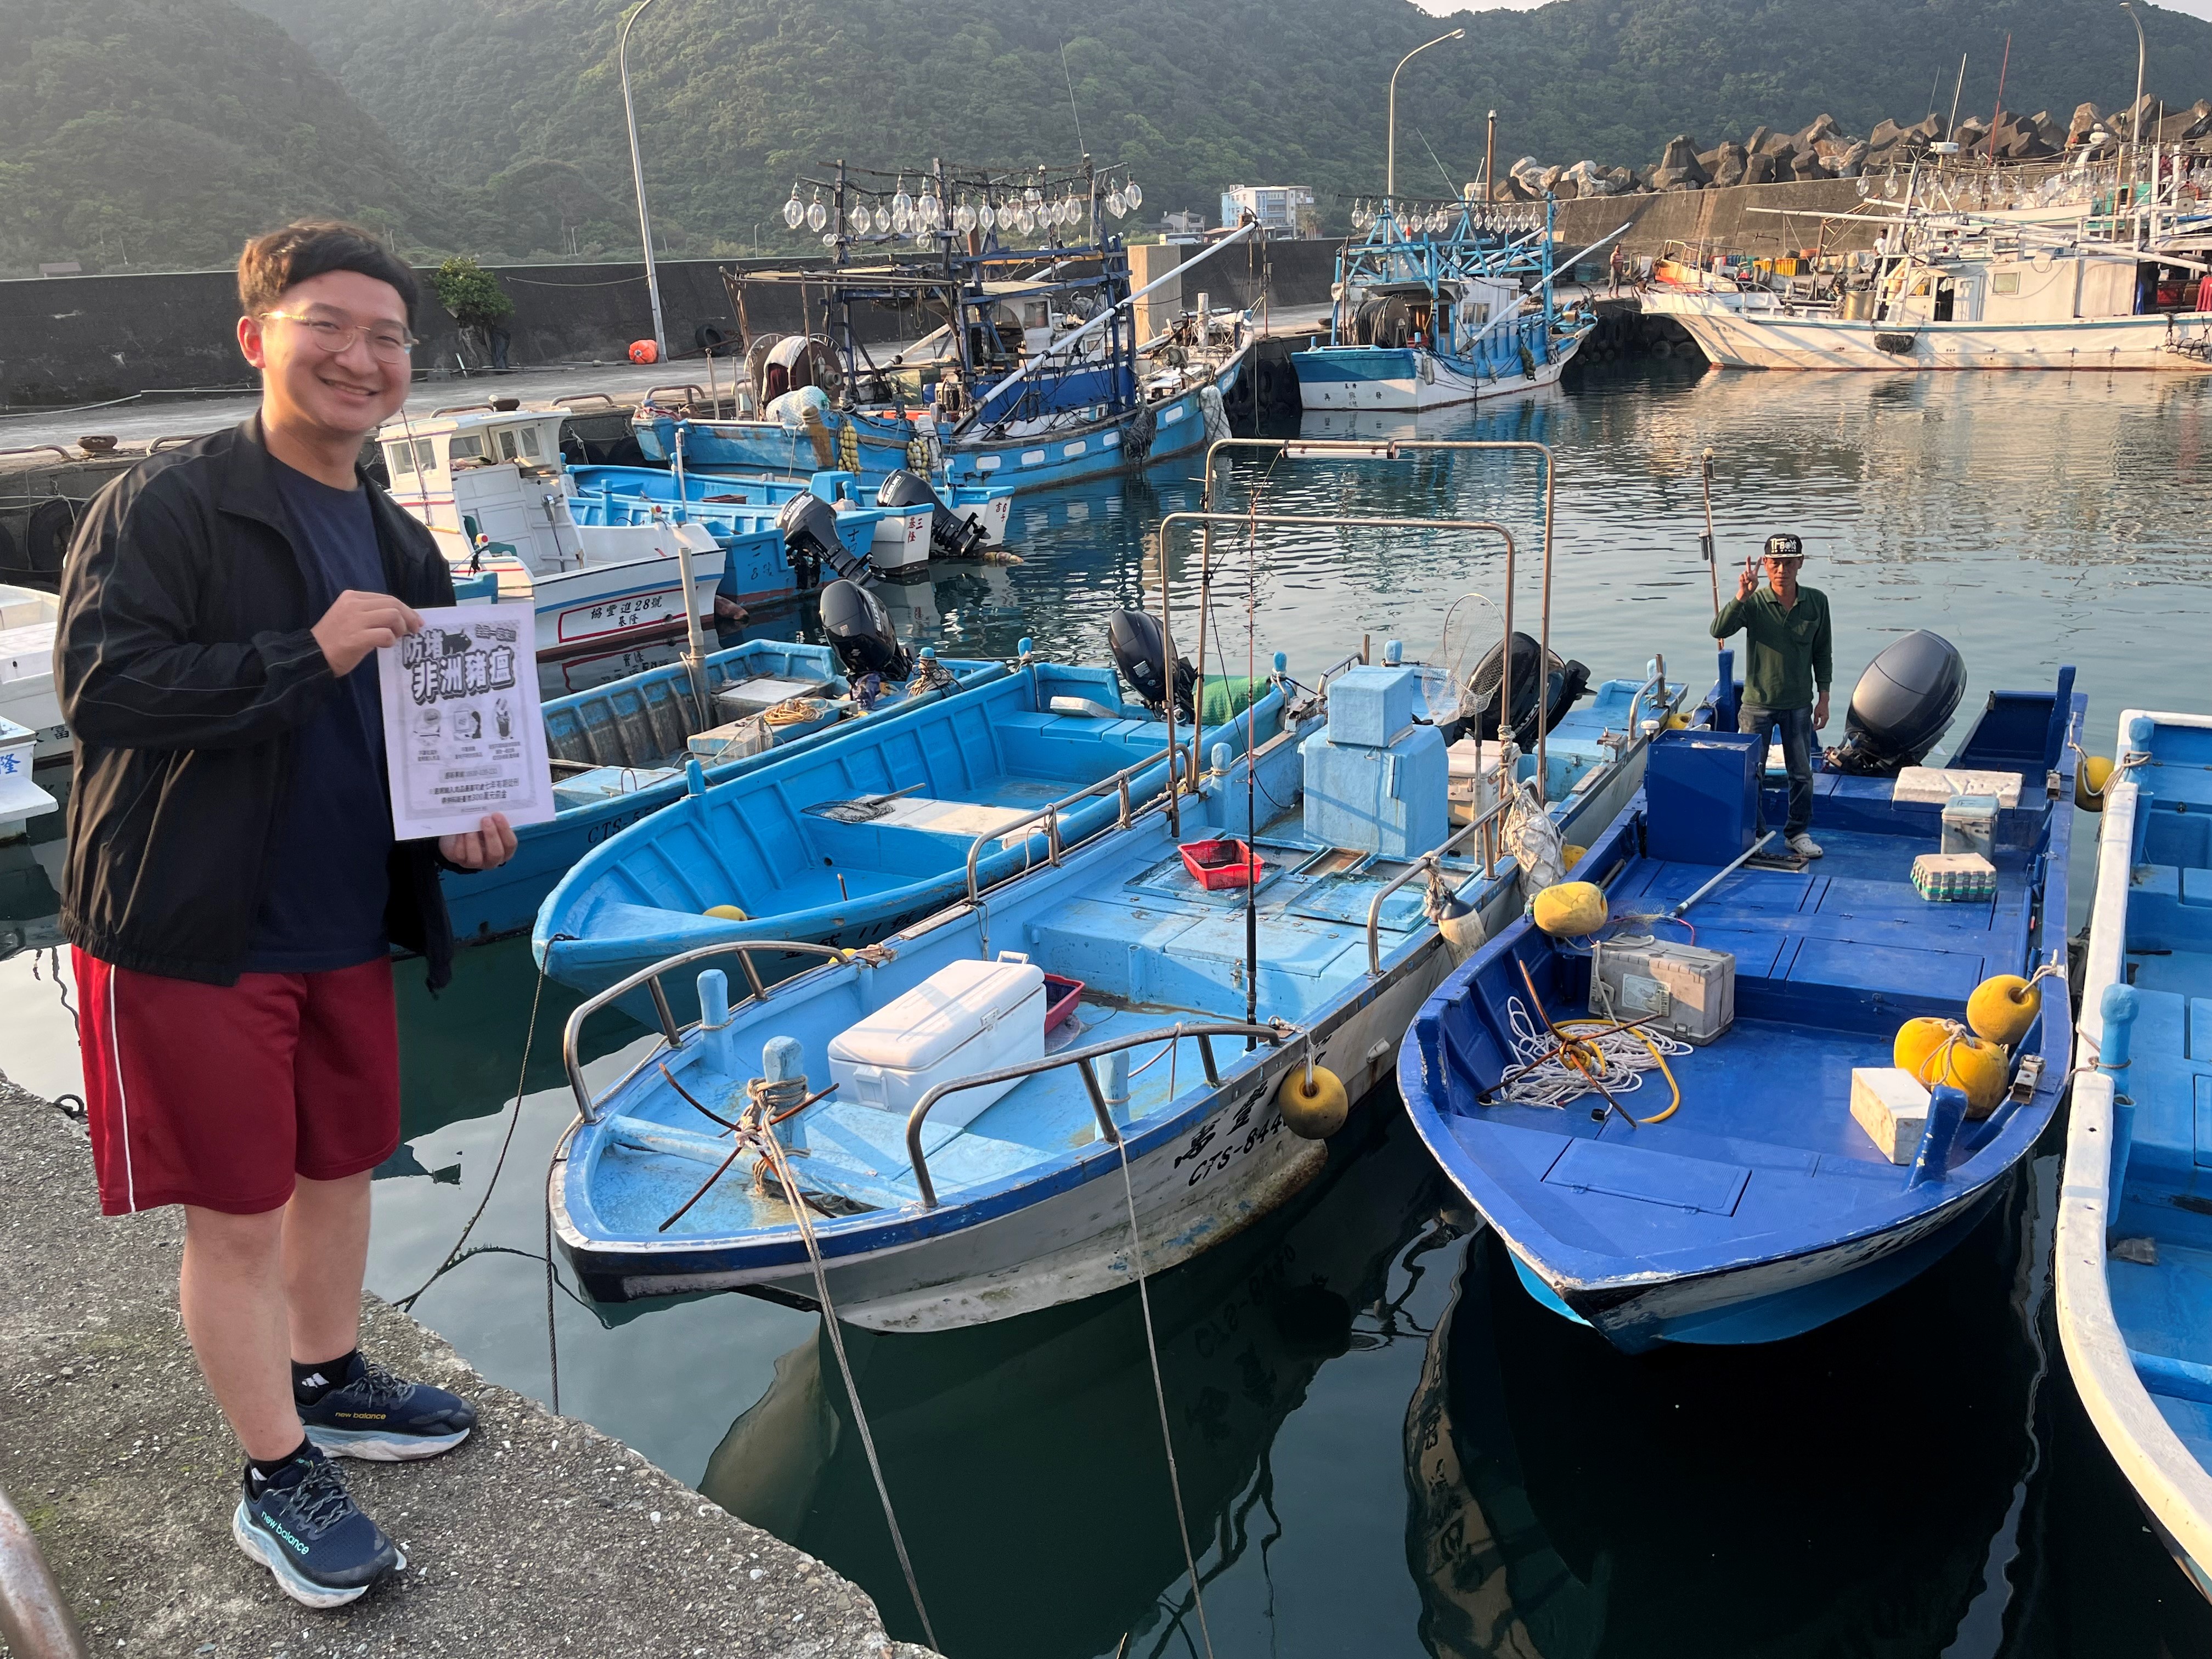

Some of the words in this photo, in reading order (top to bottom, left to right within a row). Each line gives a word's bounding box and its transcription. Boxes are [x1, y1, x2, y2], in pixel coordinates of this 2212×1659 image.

[884, 475, 902, 503] SUZUKI
[783, 495, 807, 521] SUZUKI
[1770, 538, 1797, 550] TFBOYS
[618, 613, 639, 627] 基隆
[402, 630, 444, 667] 防堵
[413, 646, 514, 702] 非洲豬瘟
[1188, 1113, 1288, 1187] CTS-844
[353, 1412, 386, 1420] balance
[261, 1510, 277, 1530] new
[275, 1523, 310, 1555] balance
